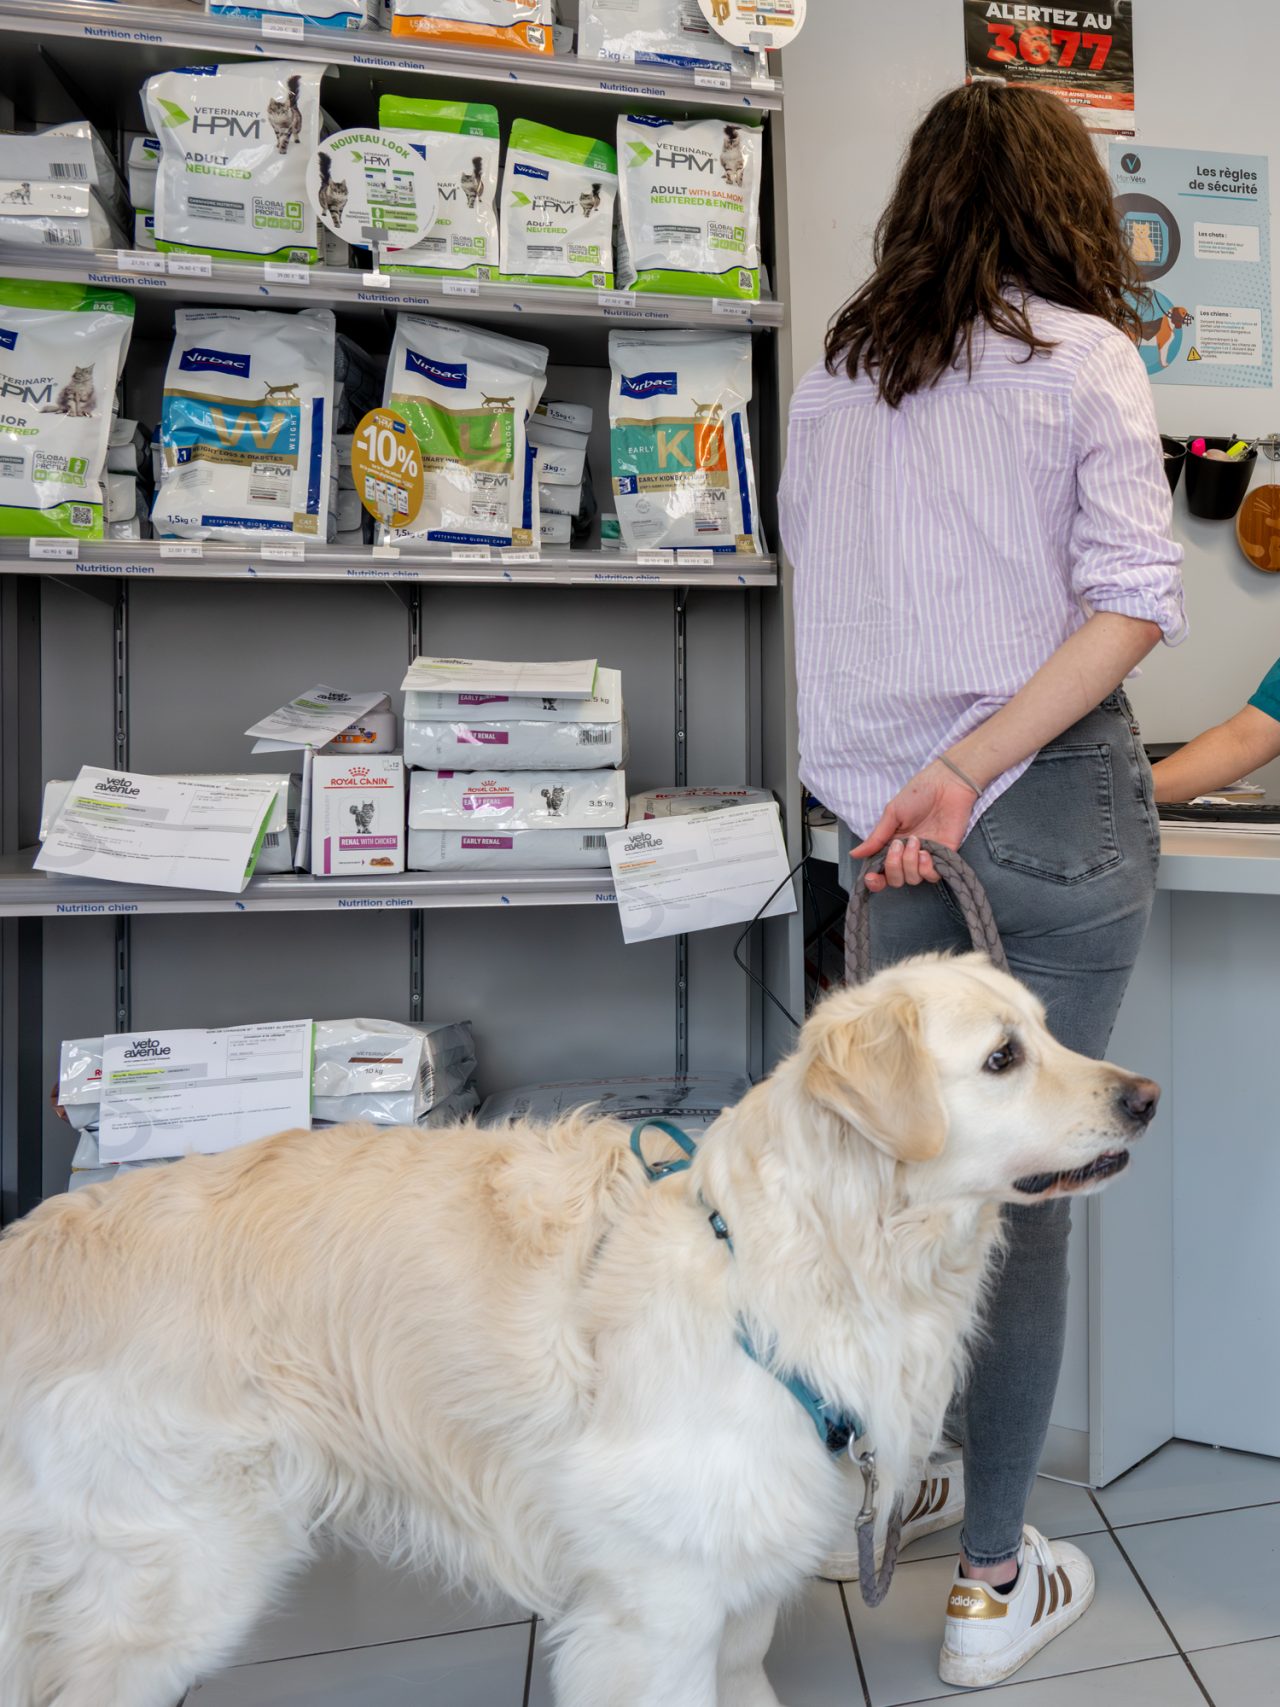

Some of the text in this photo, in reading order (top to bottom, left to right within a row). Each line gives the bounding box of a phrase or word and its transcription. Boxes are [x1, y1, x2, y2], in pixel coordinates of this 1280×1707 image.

[986, 2, 1112, 30] ALERTEZ AU
[84, 26, 163, 43] Nutrition chien
[987, 23, 1112, 70] 3677
[353, 55, 425, 70] Nutrition chien
[600, 82, 666, 97] Nutrition chien
[194, 106, 261, 118] VETERINARY
[330, 134, 411, 160] NOUVEAU LOOK
[656, 142, 713, 158] VETERINARY
[185, 152, 229, 166] ADULT
[186, 163, 252, 180] NEUTERED
[1196, 166, 1258, 182] Les règles
[1188, 179, 1258, 194] de sécurité
[650, 186, 744, 202] ADULT WITH SALMON
[254, 200, 285, 208] GLOBAL
[255, 208, 285, 217] PROFILE
[88, 273, 167, 287] Nutrition chien
[357, 292, 430, 305] Nutrition chien
[93, 304, 114, 312] BAG
[603, 309, 669, 320] Nutrition chien
[186, 352, 246, 369] Virbac
[410, 354, 463, 380] Virbac
[0, 373, 54, 386] TERINARY
[625, 378, 673, 392] Virbac
[0, 426, 40, 436] TERED
[209, 406, 287, 450] W
[288, 414, 297, 451] WEIGHT
[356, 425, 418, 478] -10%
[628, 446, 654, 455] EARLY
[656, 429, 694, 469] K
[36, 453, 68, 463] GLOBAL
[638, 474, 658, 483] EARLY
[167, 515, 189, 526] 1,5kg
[208, 518, 245, 526] VETERINARY
[434, 534, 468, 542] VETERINARY
[76, 564, 155, 574] Nutrition chien
[594, 574, 660, 582] Nutrition chien
[106, 776, 133, 788] veto
[330, 778, 388, 786] ROYAL CANIN
[95, 782, 140, 796] avenue
[341, 838, 397, 846] RENAL WITH CHICKEN
[628, 832, 652, 844] veto
[624, 838, 663, 852] avenue
[56, 902, 138, 913] Nutrition chien
[338, 898, 413, 908] Nutrition chien
[132, 1038, 160, 1050] veto
[124, 1046, 172, 1059] avenue
